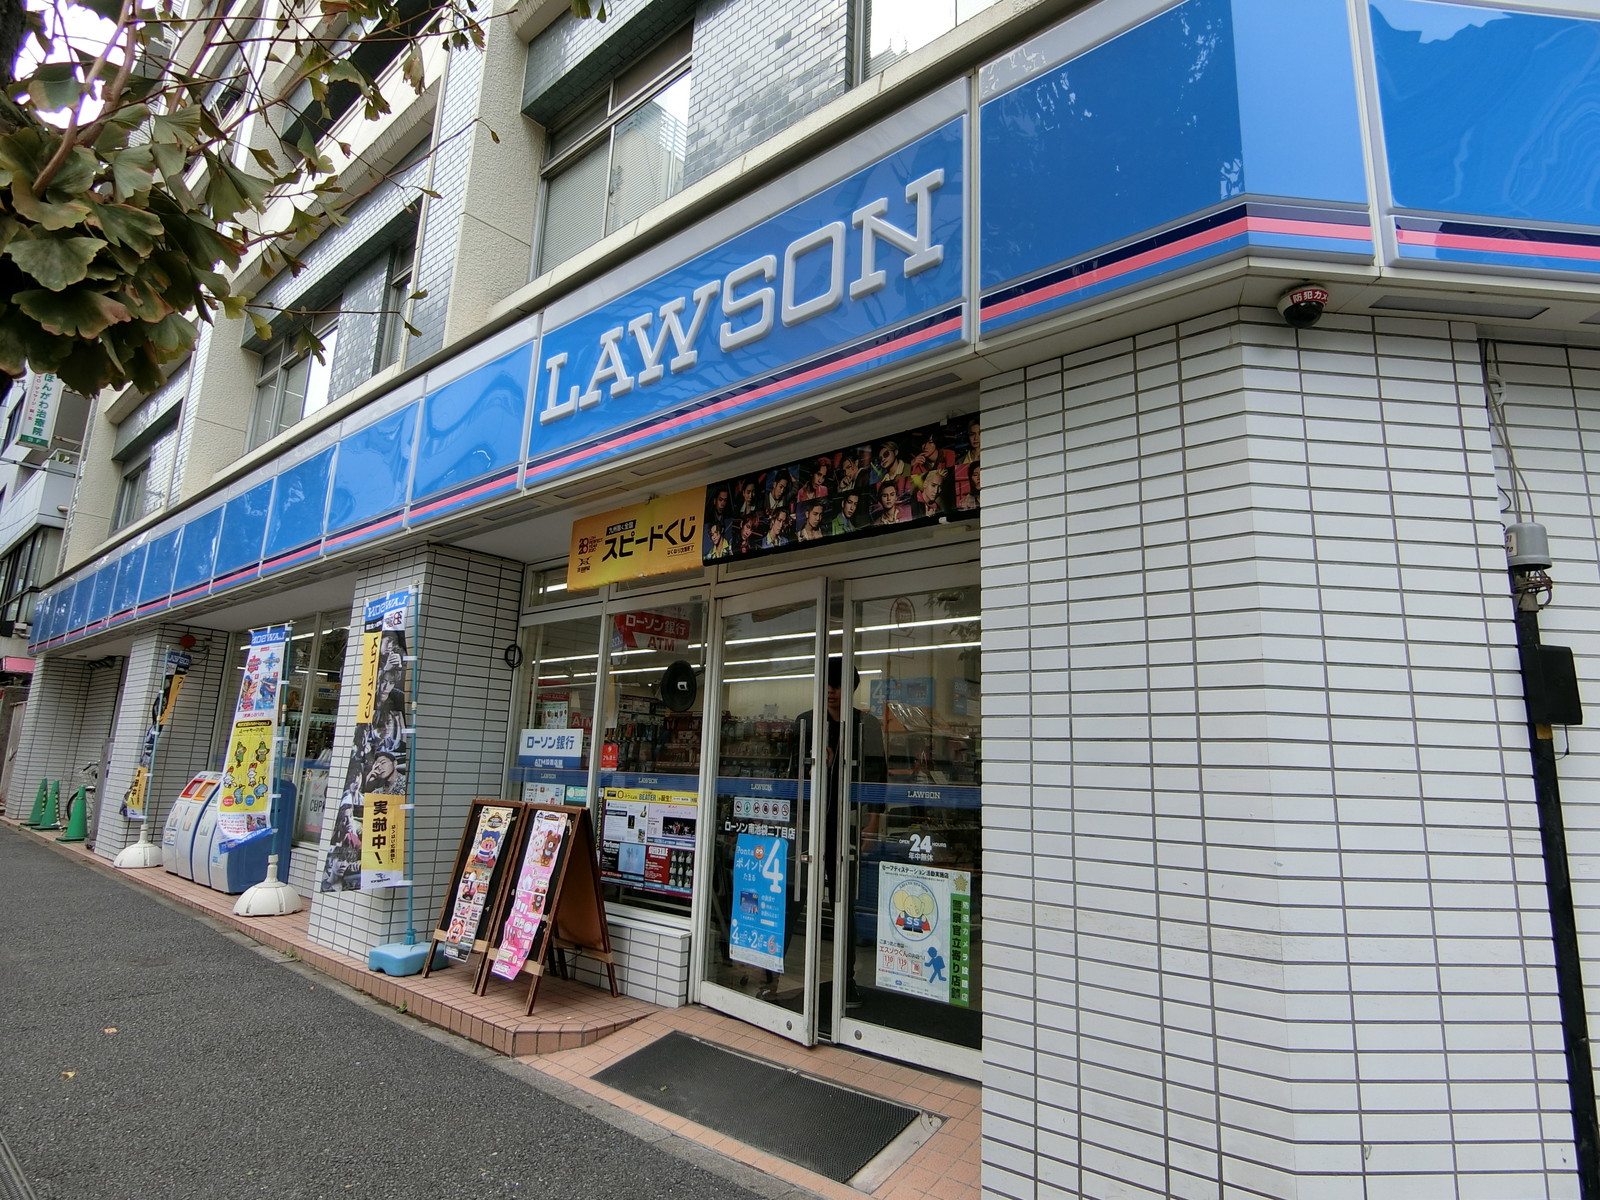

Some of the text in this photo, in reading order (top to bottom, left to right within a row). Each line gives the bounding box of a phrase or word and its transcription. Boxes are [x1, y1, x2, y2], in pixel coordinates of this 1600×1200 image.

[539, 168, 945, 426] LAWSON
[32, 373, 56, 437] ほんがわ治療院
[601, 516, 696, 563] スピードくじ
[625, 614, 687, 635] ローソン銀行
[648, 636, 676, 652] ATM
[526, 735, 575, 750] ローソン銀行
[907, 790, 941, 799] LAWSON
[736, 845, 754, 856] Ponta
[909, 833, 933, 853] 24
[735, 857, 763, 873] ポイント
[908, 852, 934, 862] 年中無休
[762, 839, 784, 894] 4
[906, 916, 920, 926] SS
[951, 899, 962, 999] 警察官立寄り店舗
[883, 955, 894, 963] 110
